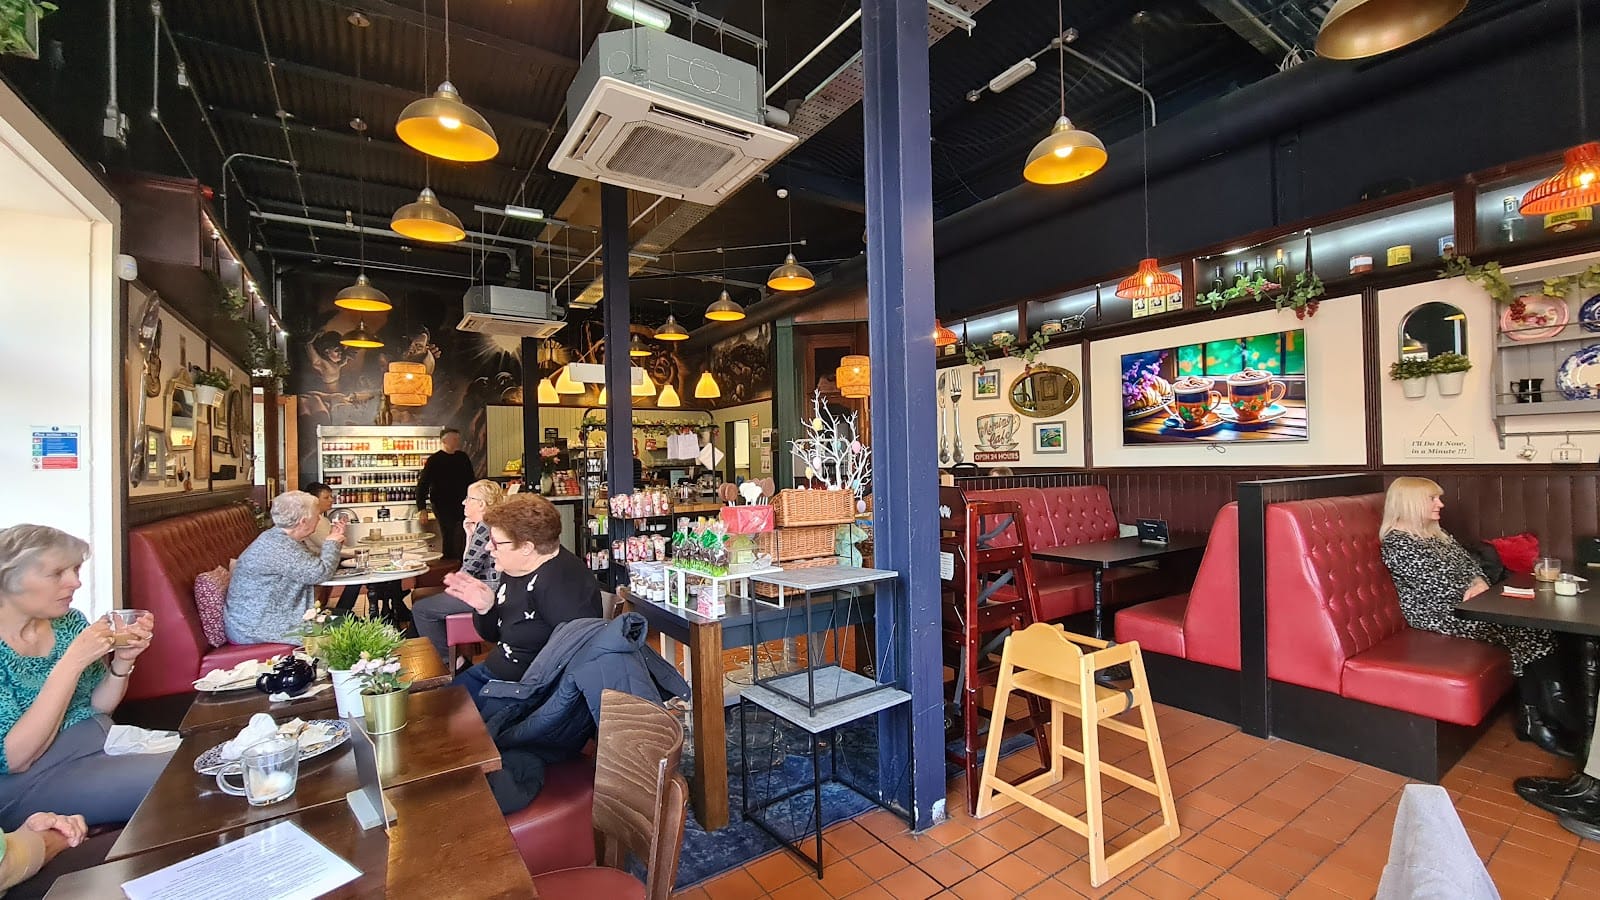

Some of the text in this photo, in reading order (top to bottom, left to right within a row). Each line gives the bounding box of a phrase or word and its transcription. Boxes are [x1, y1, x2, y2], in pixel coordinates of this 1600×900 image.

[980, 416, 1011, 438] Morning
[975, 453, 989, 461] OPEN
[998, 452, 1019, 460] HOURS
